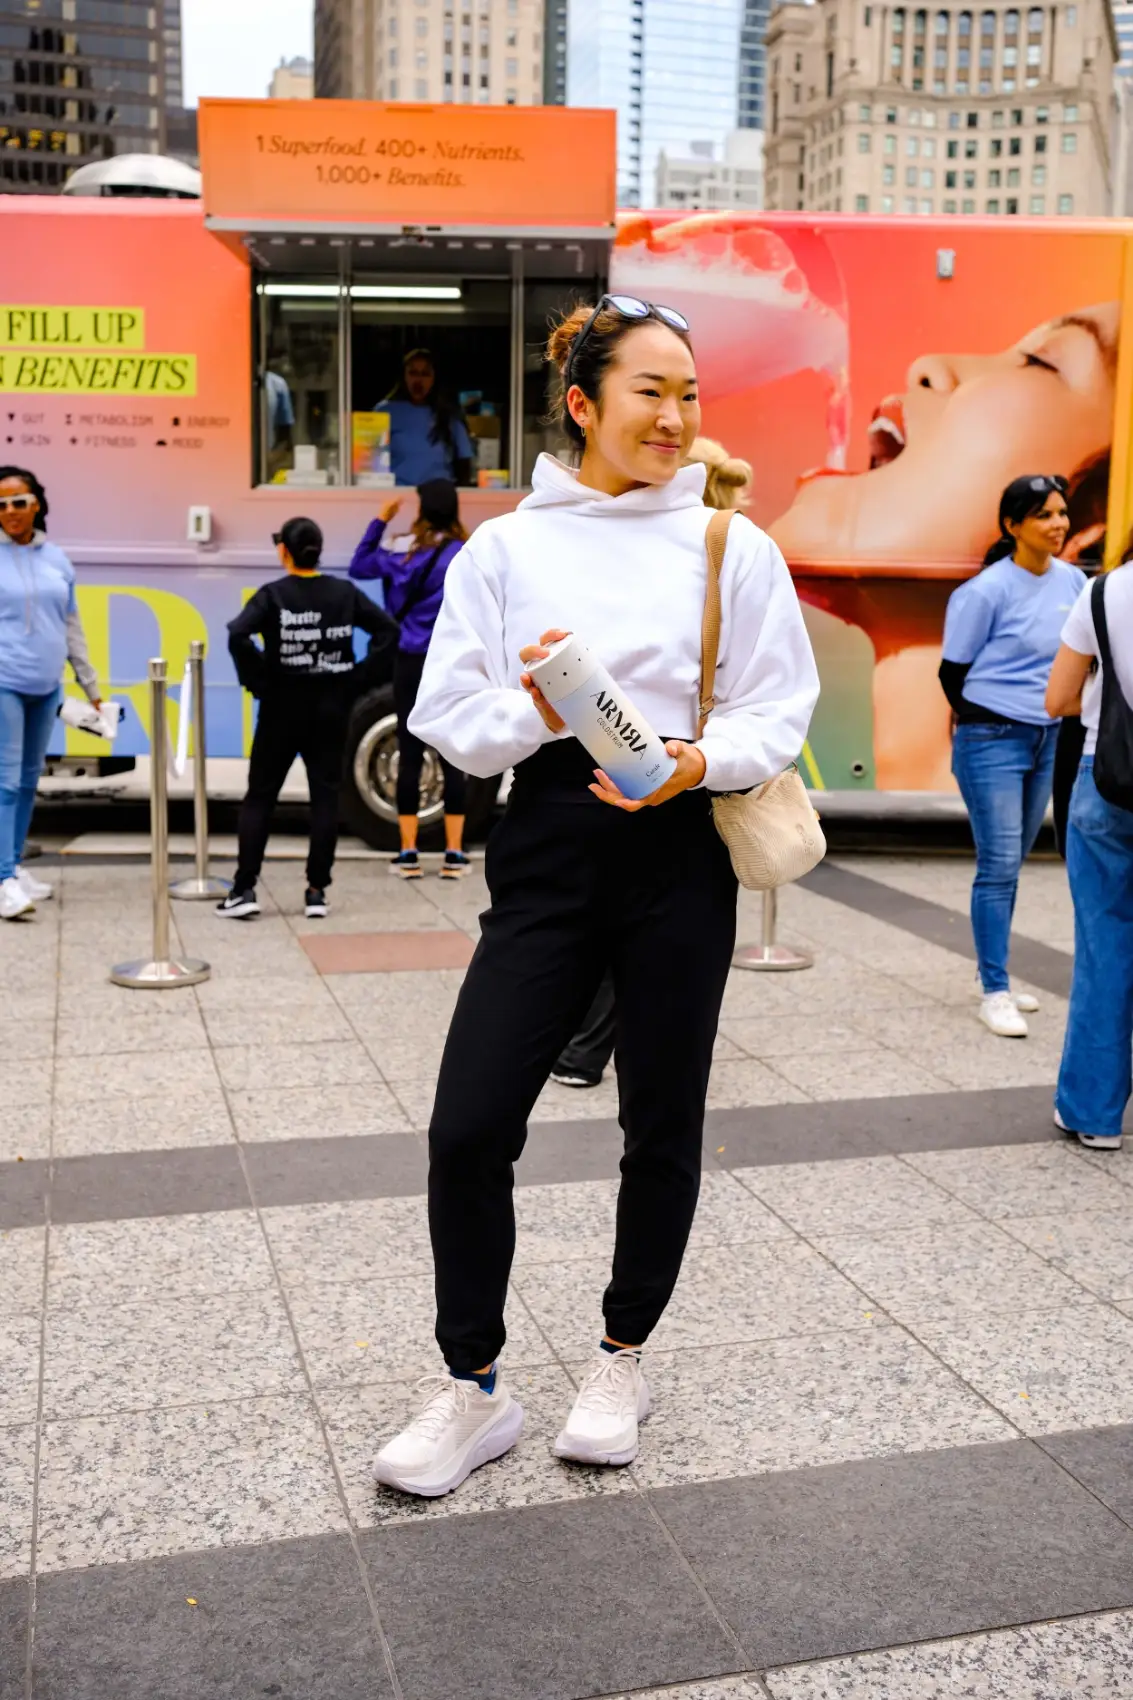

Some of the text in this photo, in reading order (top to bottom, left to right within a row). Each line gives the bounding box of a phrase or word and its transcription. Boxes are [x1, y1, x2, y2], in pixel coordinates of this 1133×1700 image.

[269, 135, 367, 157] Superfood.
[375, 139, 427, 158] 400+
[432, 141, 526, 162] Nutrients.
[315, 164, 467, 188] 1,000+ Benefits.
[7, 310, 137, 344] FILL UP
[14, 355, 190, 391] BENEFITS
[79, 414, 154, 427] METABOLISM
[596, 717, 624, 749] COLOSTRUM
